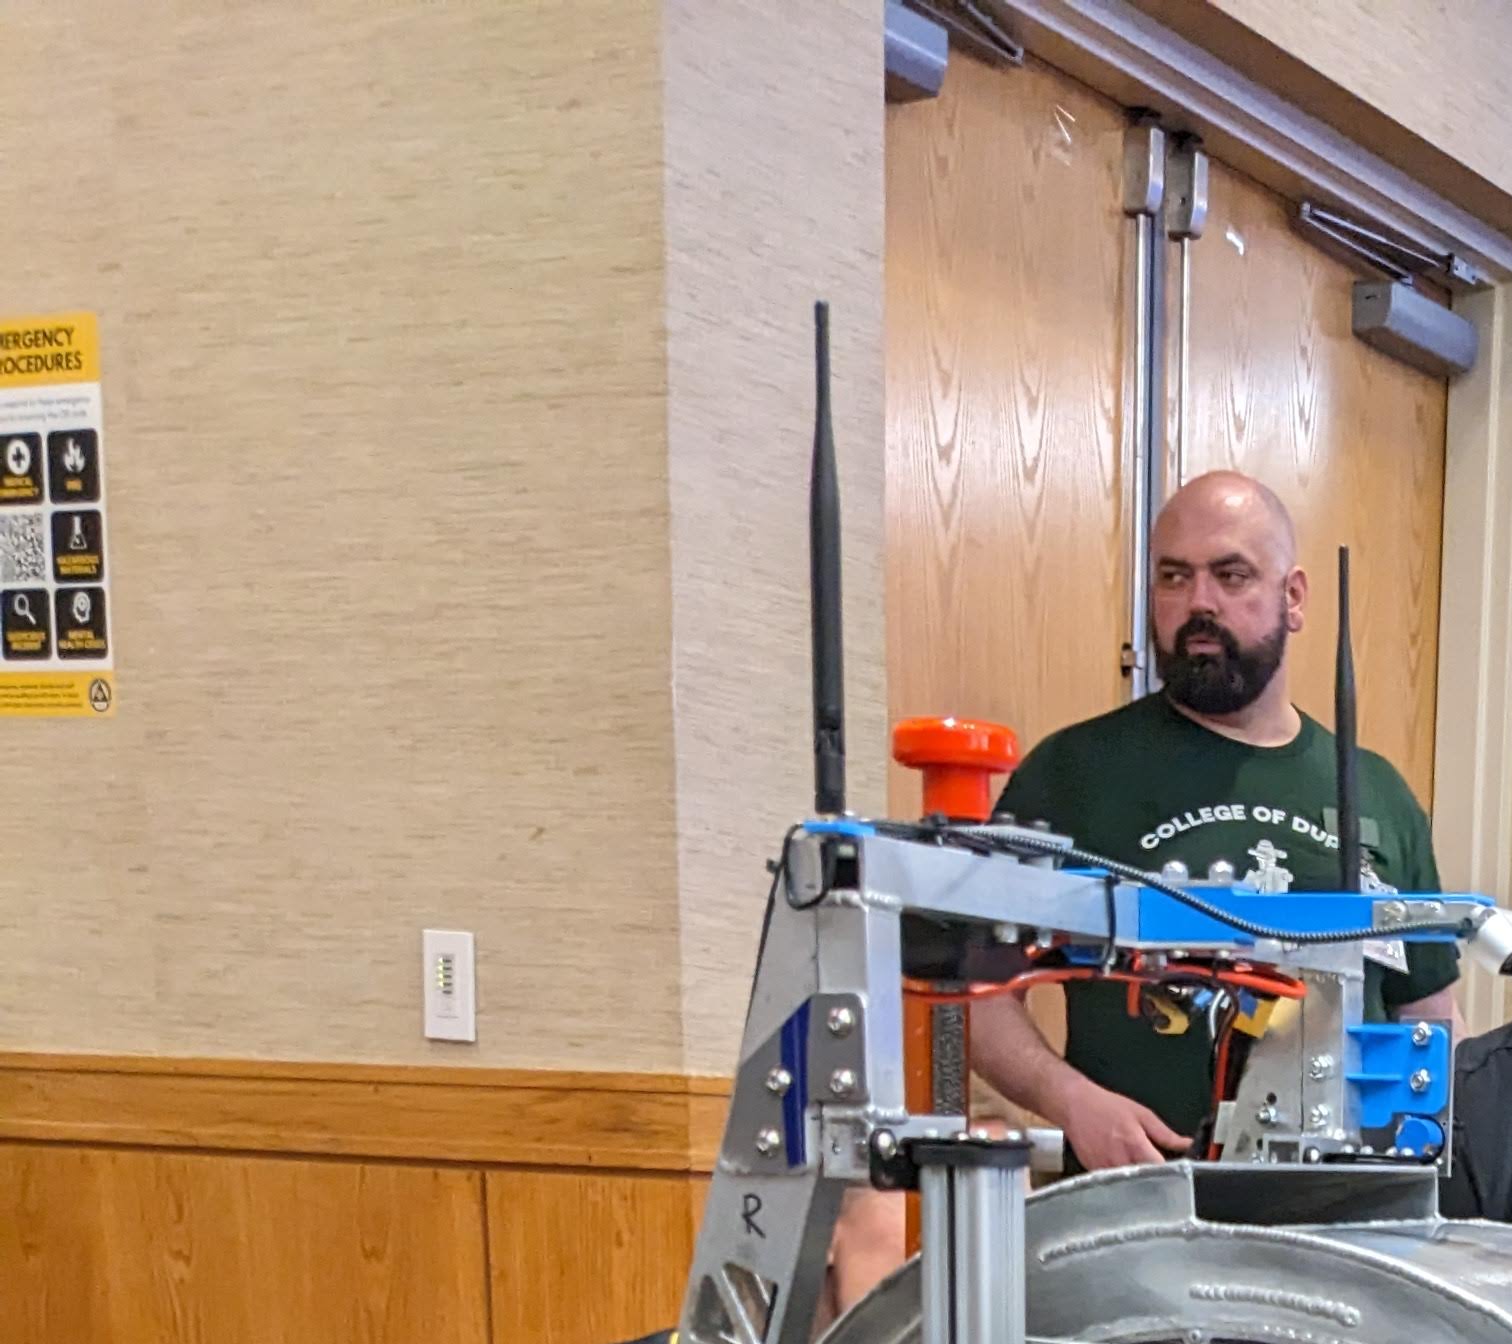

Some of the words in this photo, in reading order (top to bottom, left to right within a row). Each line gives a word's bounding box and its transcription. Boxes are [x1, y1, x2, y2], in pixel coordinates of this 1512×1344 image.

[0, 327, 74, 351] ERGENCY
[0, 351, 82, 375] OCEDURES
[1140, 804, 1246, 850] COLLEGE
[1252, 806, 1286, 825] OF
[742, 1193, 767, 1239] R
